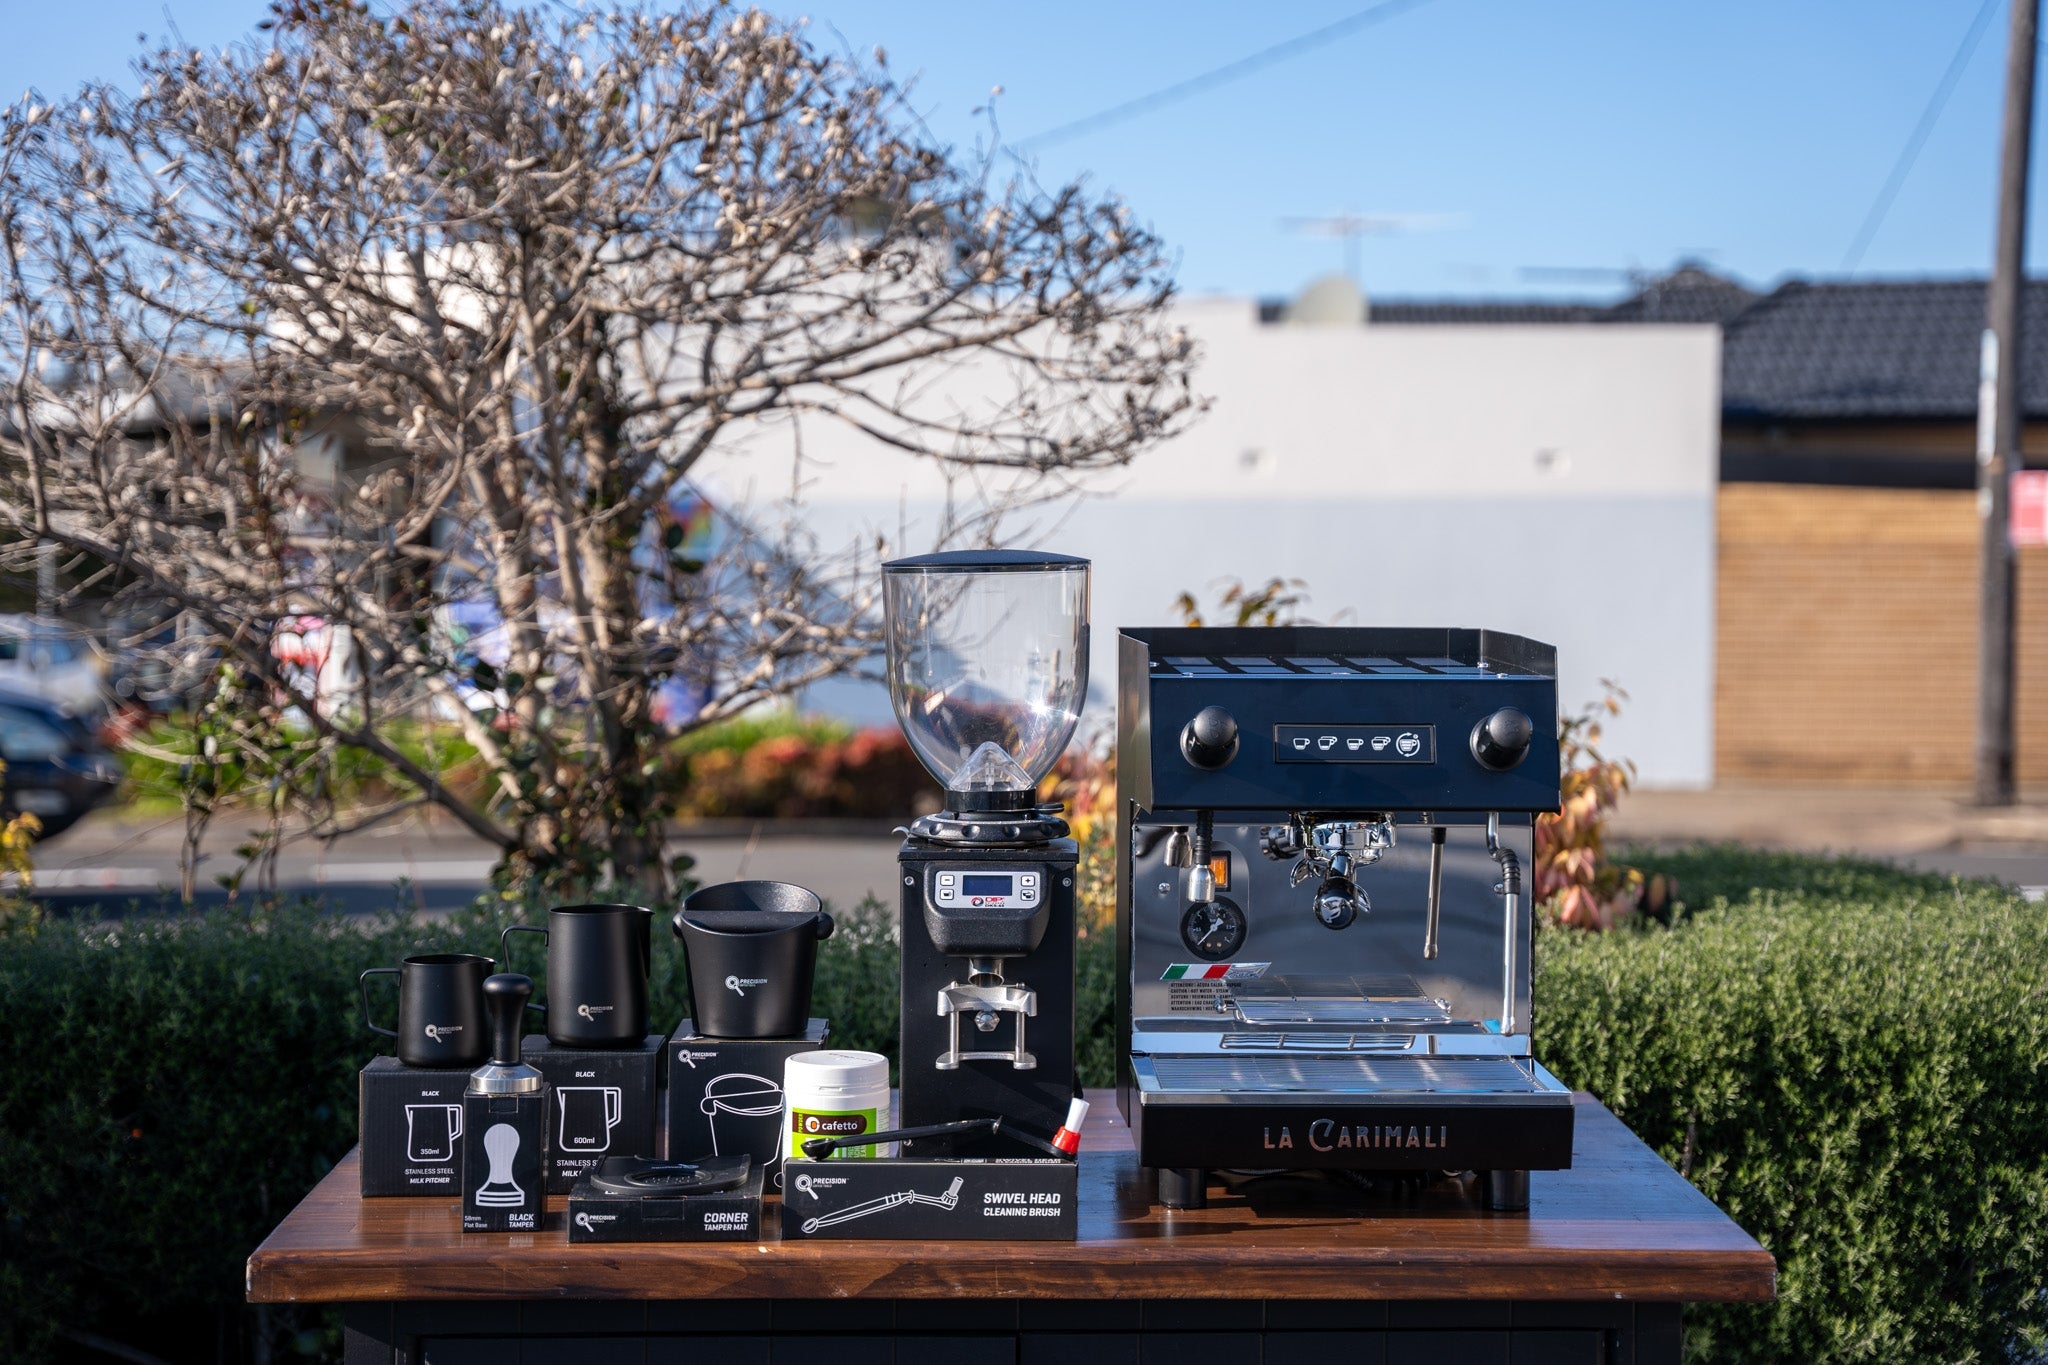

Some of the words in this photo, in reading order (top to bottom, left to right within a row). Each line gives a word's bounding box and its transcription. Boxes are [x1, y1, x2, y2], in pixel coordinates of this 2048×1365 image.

[821, 1120, 858, 1131] cafetto
[1263, 1126, 1294, 1149] LA
[1308, 1118, 1447, 1152] CARIMALI
[556, 1159, 591, 1167] STAINLESS
[812, 1177, 847, 1185] PRECISION
[983, 1193, 1027, 1204] SWIVEL
[1029, 1193, 1061, 1204] HEAD
[508, 1213, 535, 1221] BLACK
[983, 1207, 1028, 1217] CLEANING
[1028, 1207, 1061, 1217] BRUSH
[703, 1212, 749, 1223] CORNER
[703, 1223, 732, 1231] TAMPER
[733, 1223, 749, 1231] MAT
